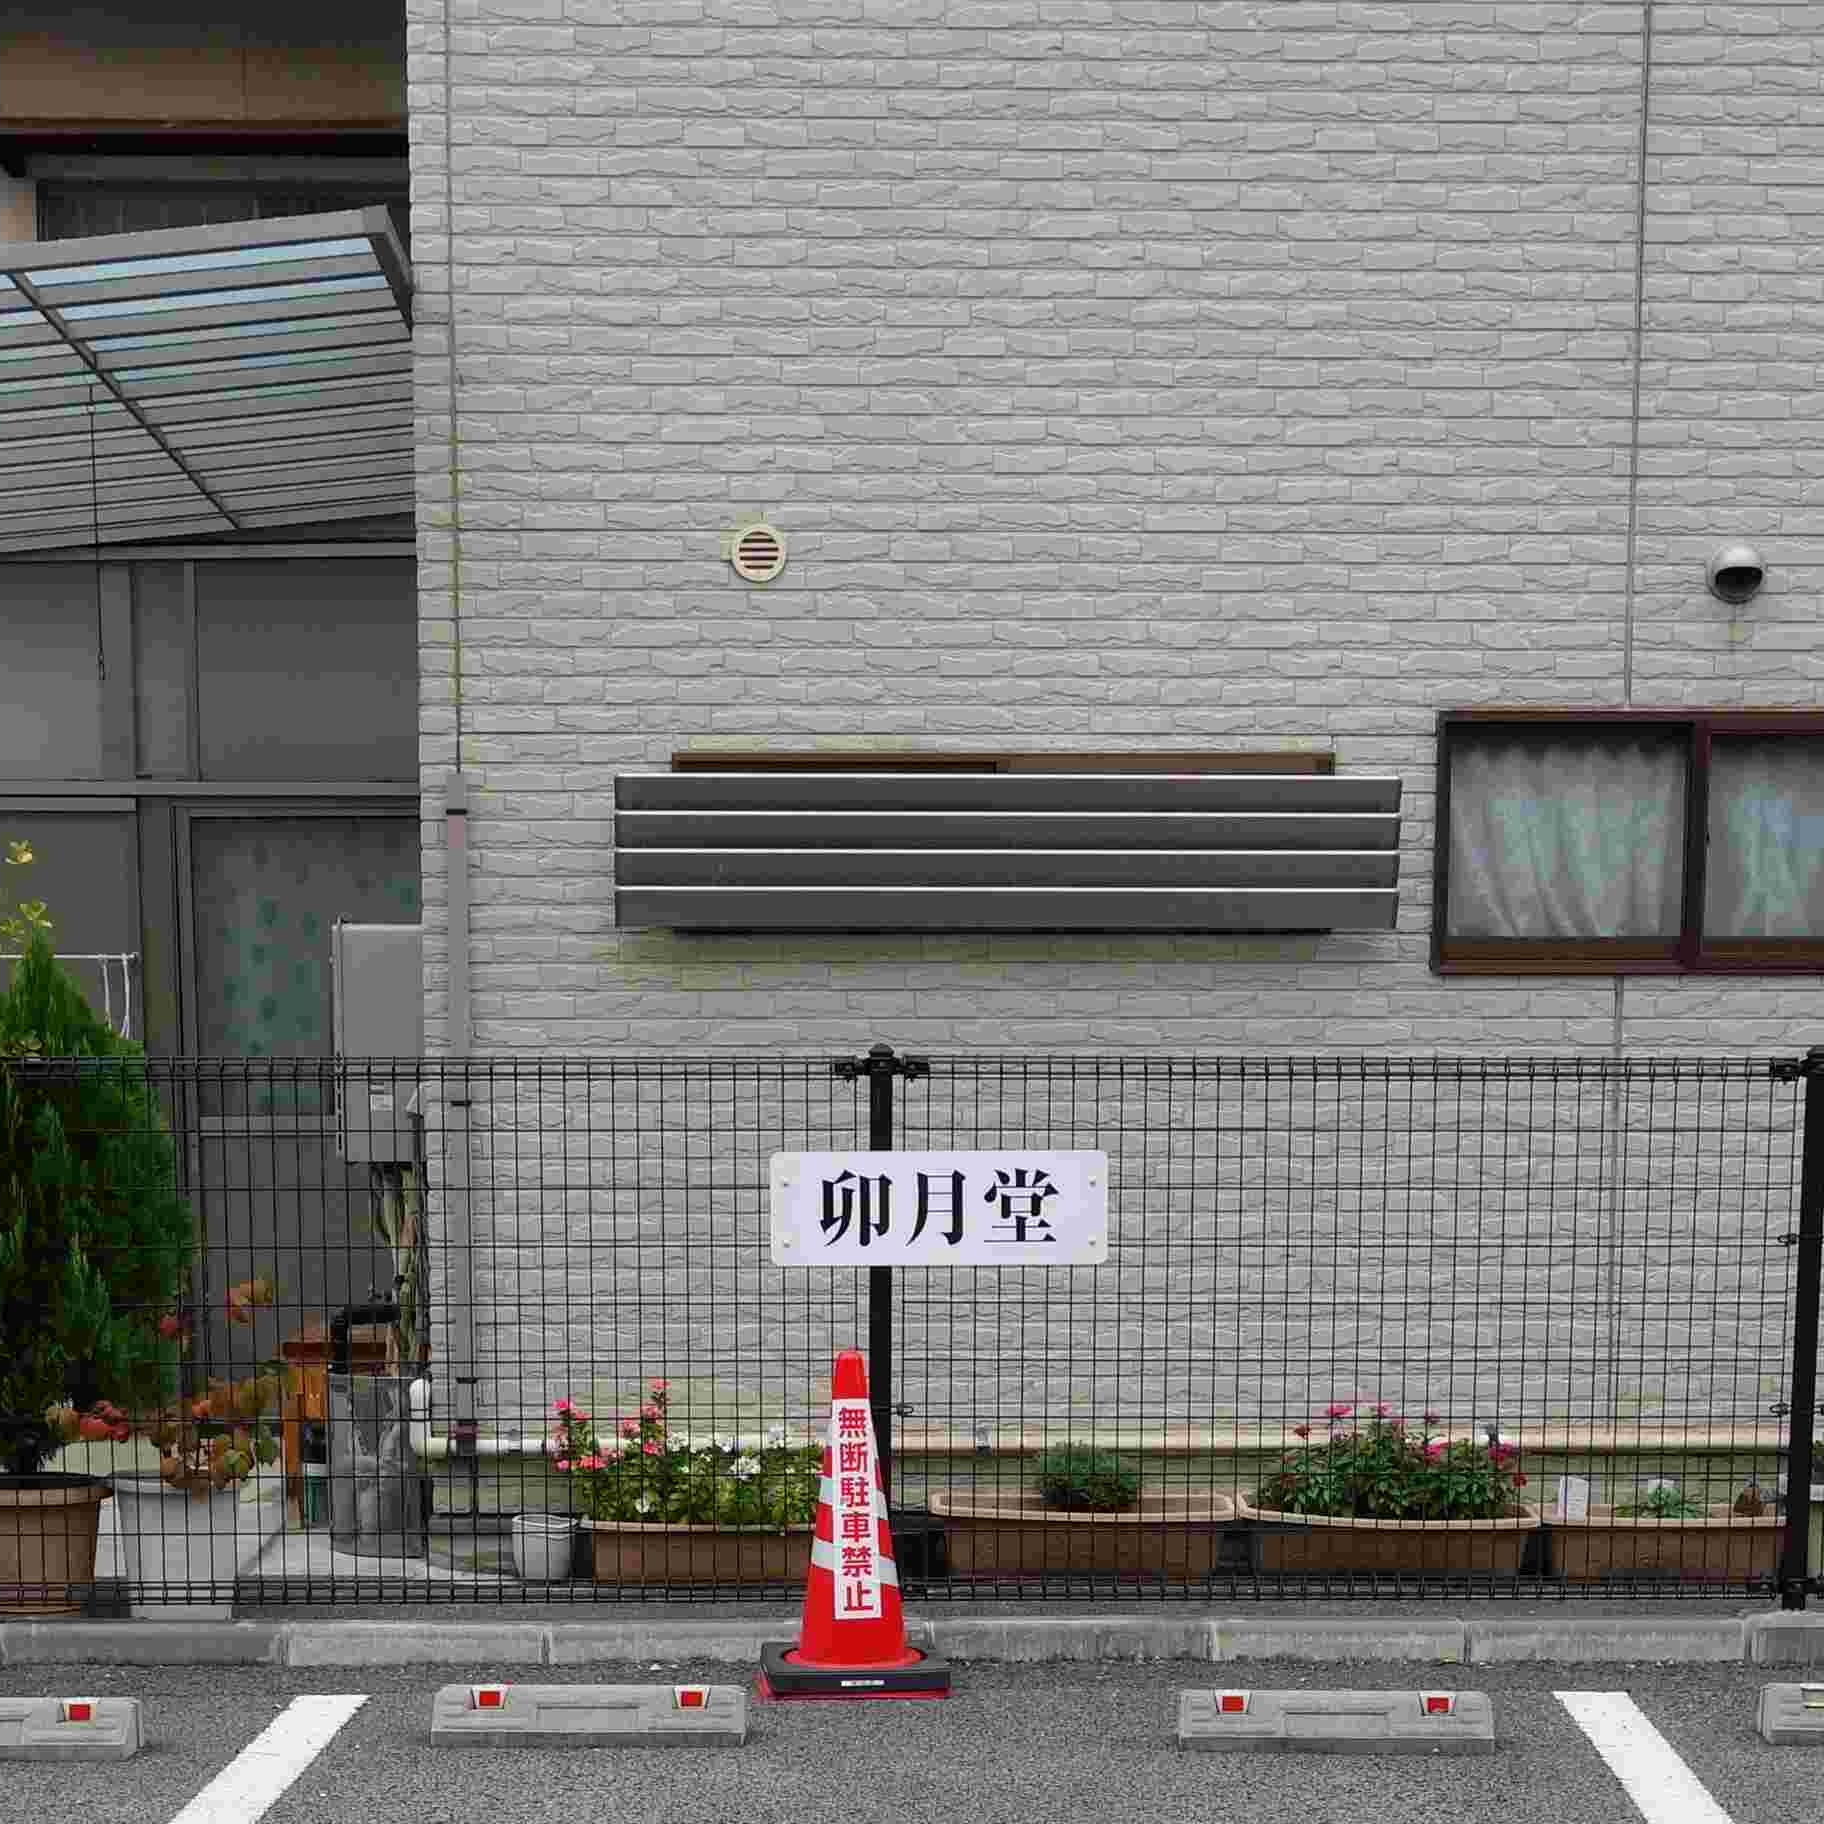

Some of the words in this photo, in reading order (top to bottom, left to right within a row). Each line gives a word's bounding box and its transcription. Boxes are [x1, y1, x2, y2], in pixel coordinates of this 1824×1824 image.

[820, 1168, 1059, 1247] 卯月堂
[838, 1406, 874, 1613] 無断駐車禁止
